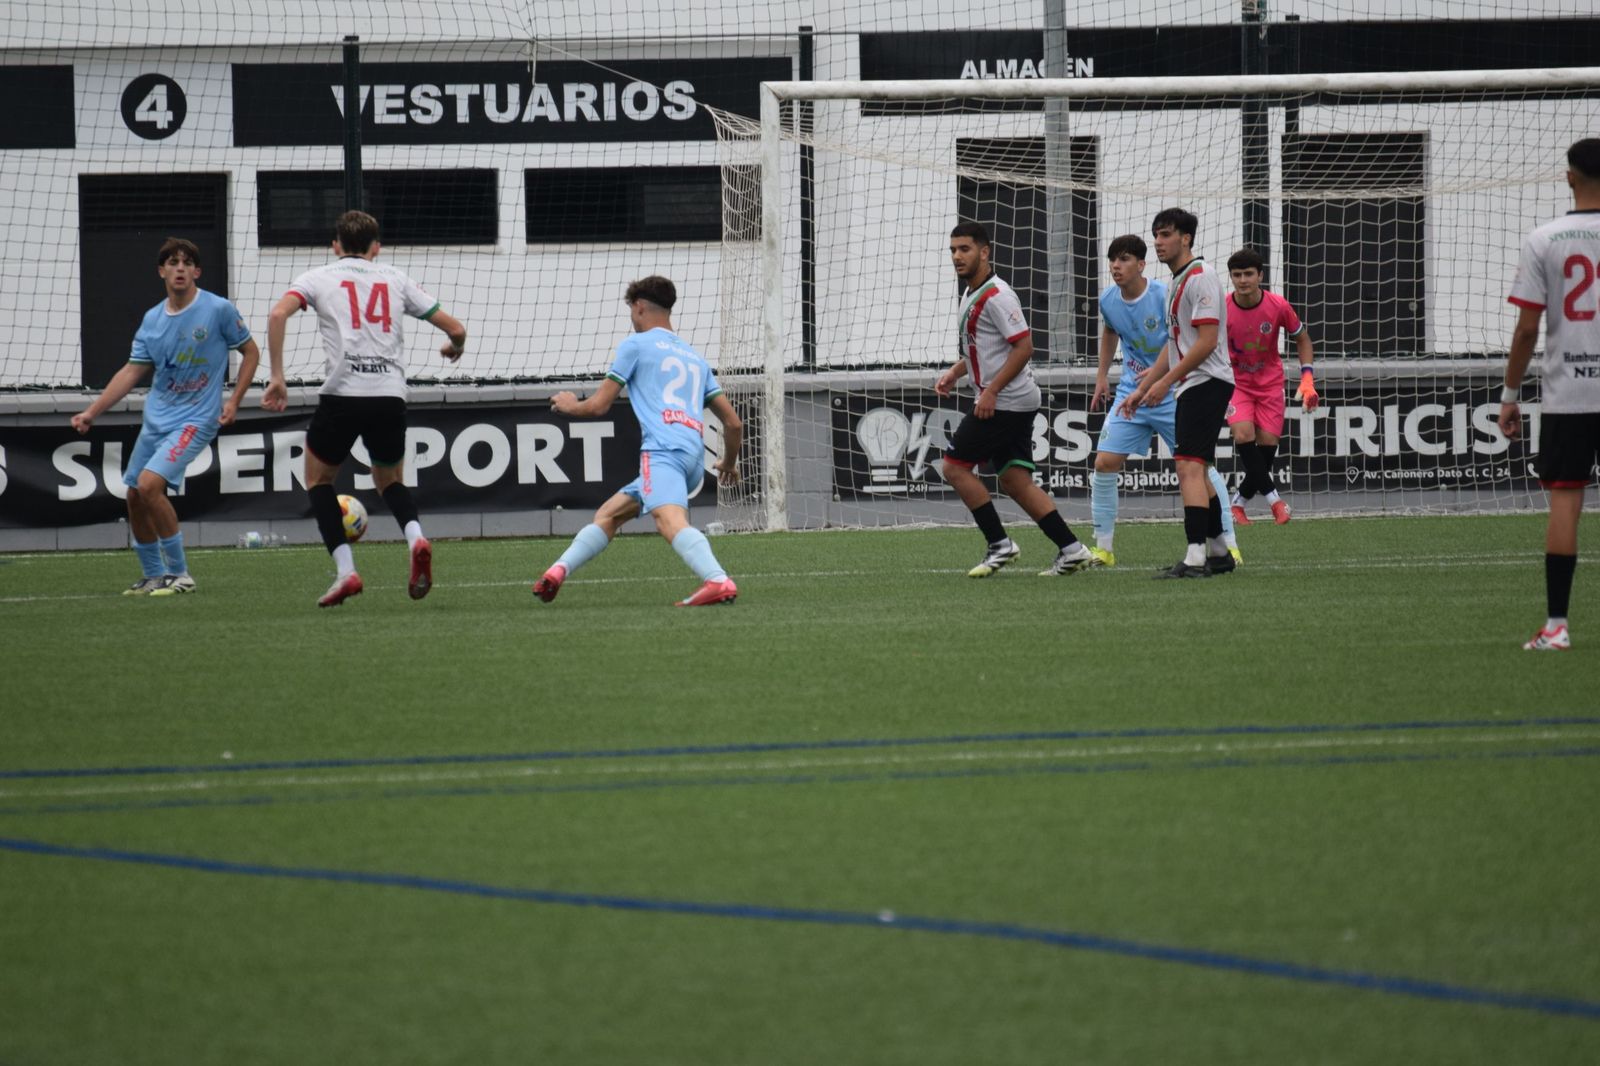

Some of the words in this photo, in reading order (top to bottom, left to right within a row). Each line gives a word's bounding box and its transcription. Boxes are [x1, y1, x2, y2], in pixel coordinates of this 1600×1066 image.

[135, 84, 173, 130] 4
[331, 80, 697, 125] VESTUARIOS
[340, 280, 391, 333] 14
[1563, 254, 1600, 322] 2
[661, 356, 701, 415] 21
[1050, 469, 1083, 488] días
[1437, 468, 1463, 478] Dato
